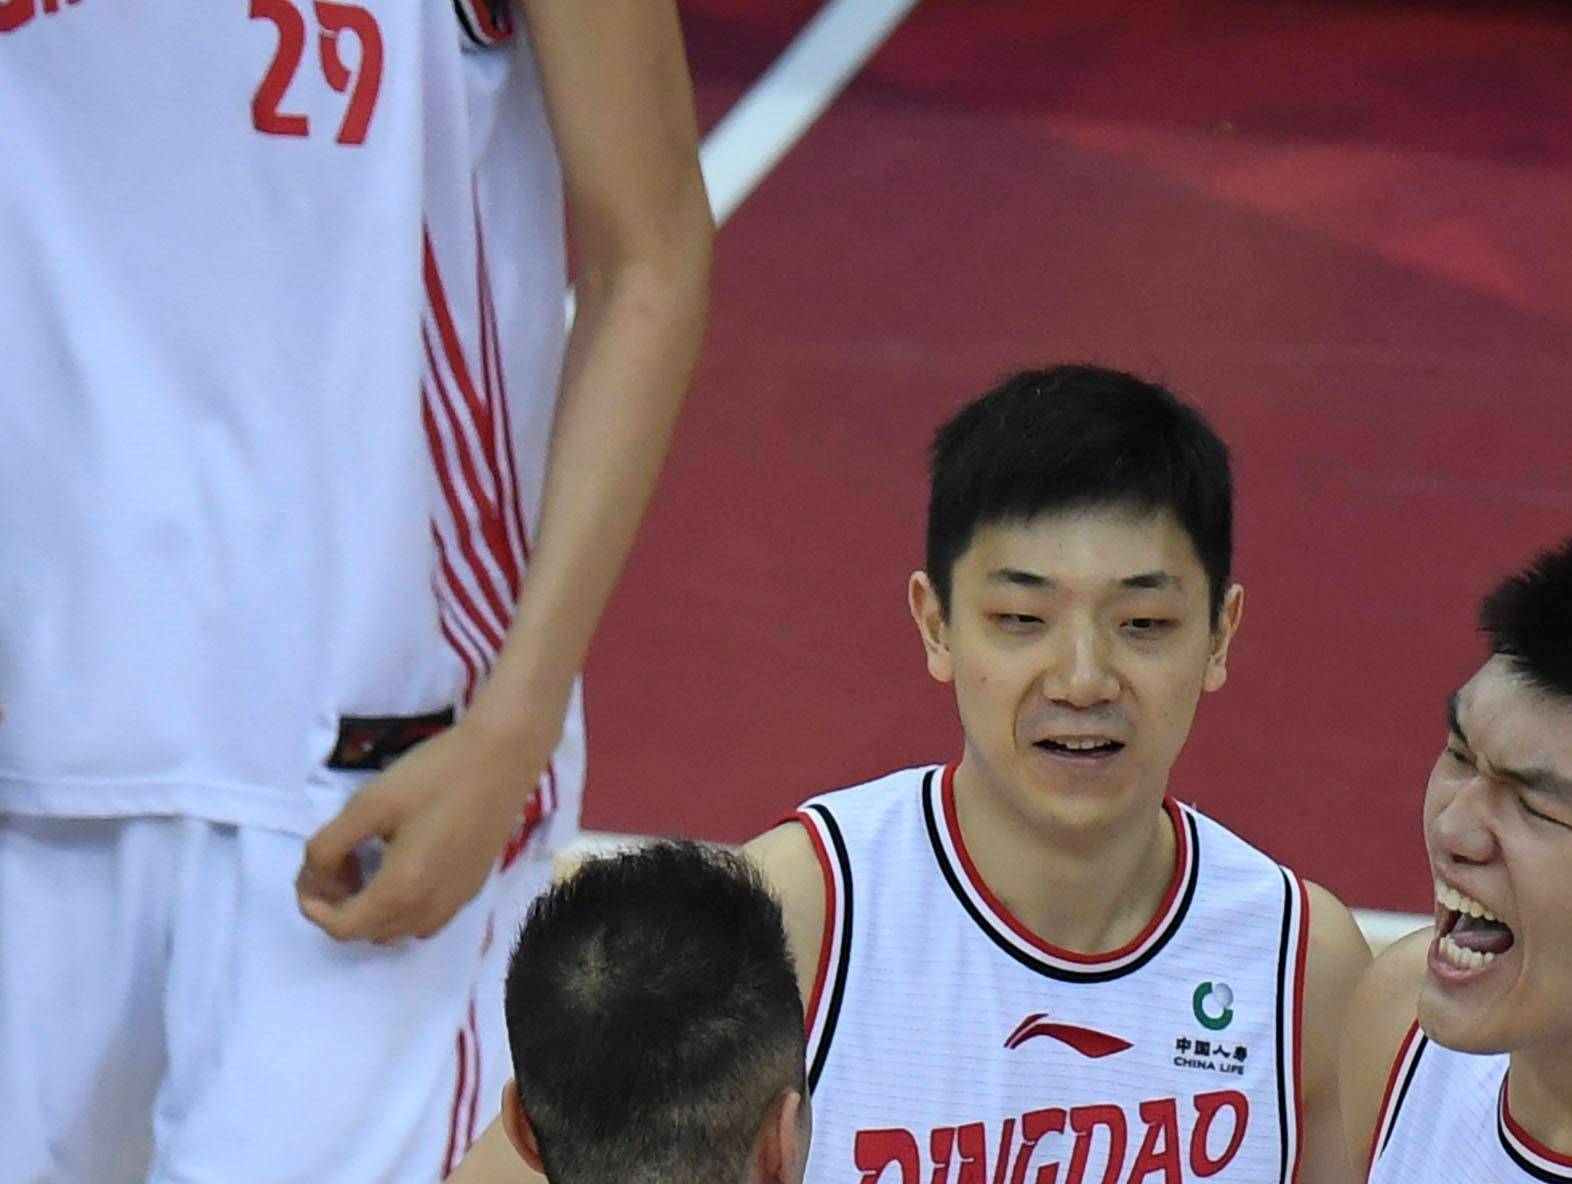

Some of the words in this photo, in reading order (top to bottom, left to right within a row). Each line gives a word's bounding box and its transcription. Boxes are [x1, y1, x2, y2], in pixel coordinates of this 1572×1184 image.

[249, 0, 384, 145] 29
[1175, 1036, 1247, 1063] 中国人寿
[1173, 1056, 1216, 1071] CHINA
[1220, 1063, 1245, 1076] LIFE
